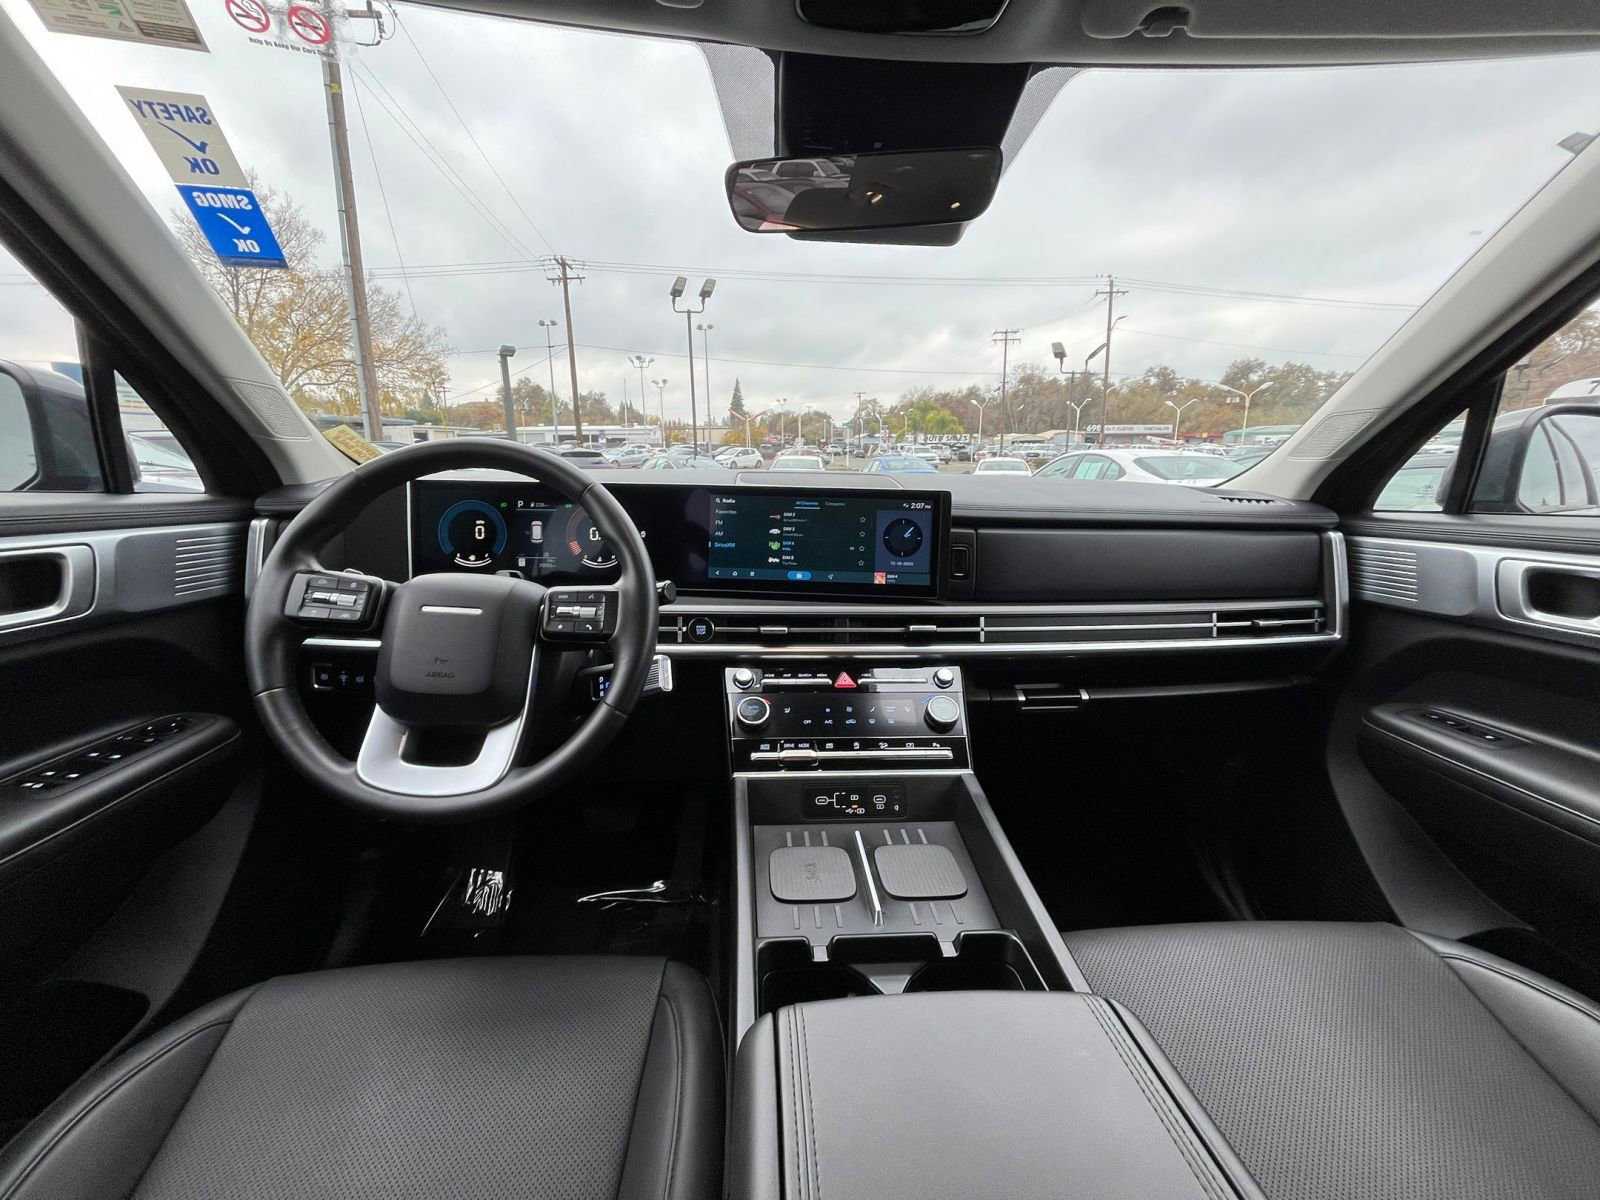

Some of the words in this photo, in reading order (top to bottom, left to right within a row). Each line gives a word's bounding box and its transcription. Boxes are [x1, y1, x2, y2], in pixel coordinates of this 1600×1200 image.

[248, 36, 264, 46] Help
[274, 41, 290, 51] Keep
[302, 47, 317, 55] Cars
[517, 500, 524, 508] P
[475, 525, 485, 540] 0
[424, 671, 456, 680] AIRBAG
